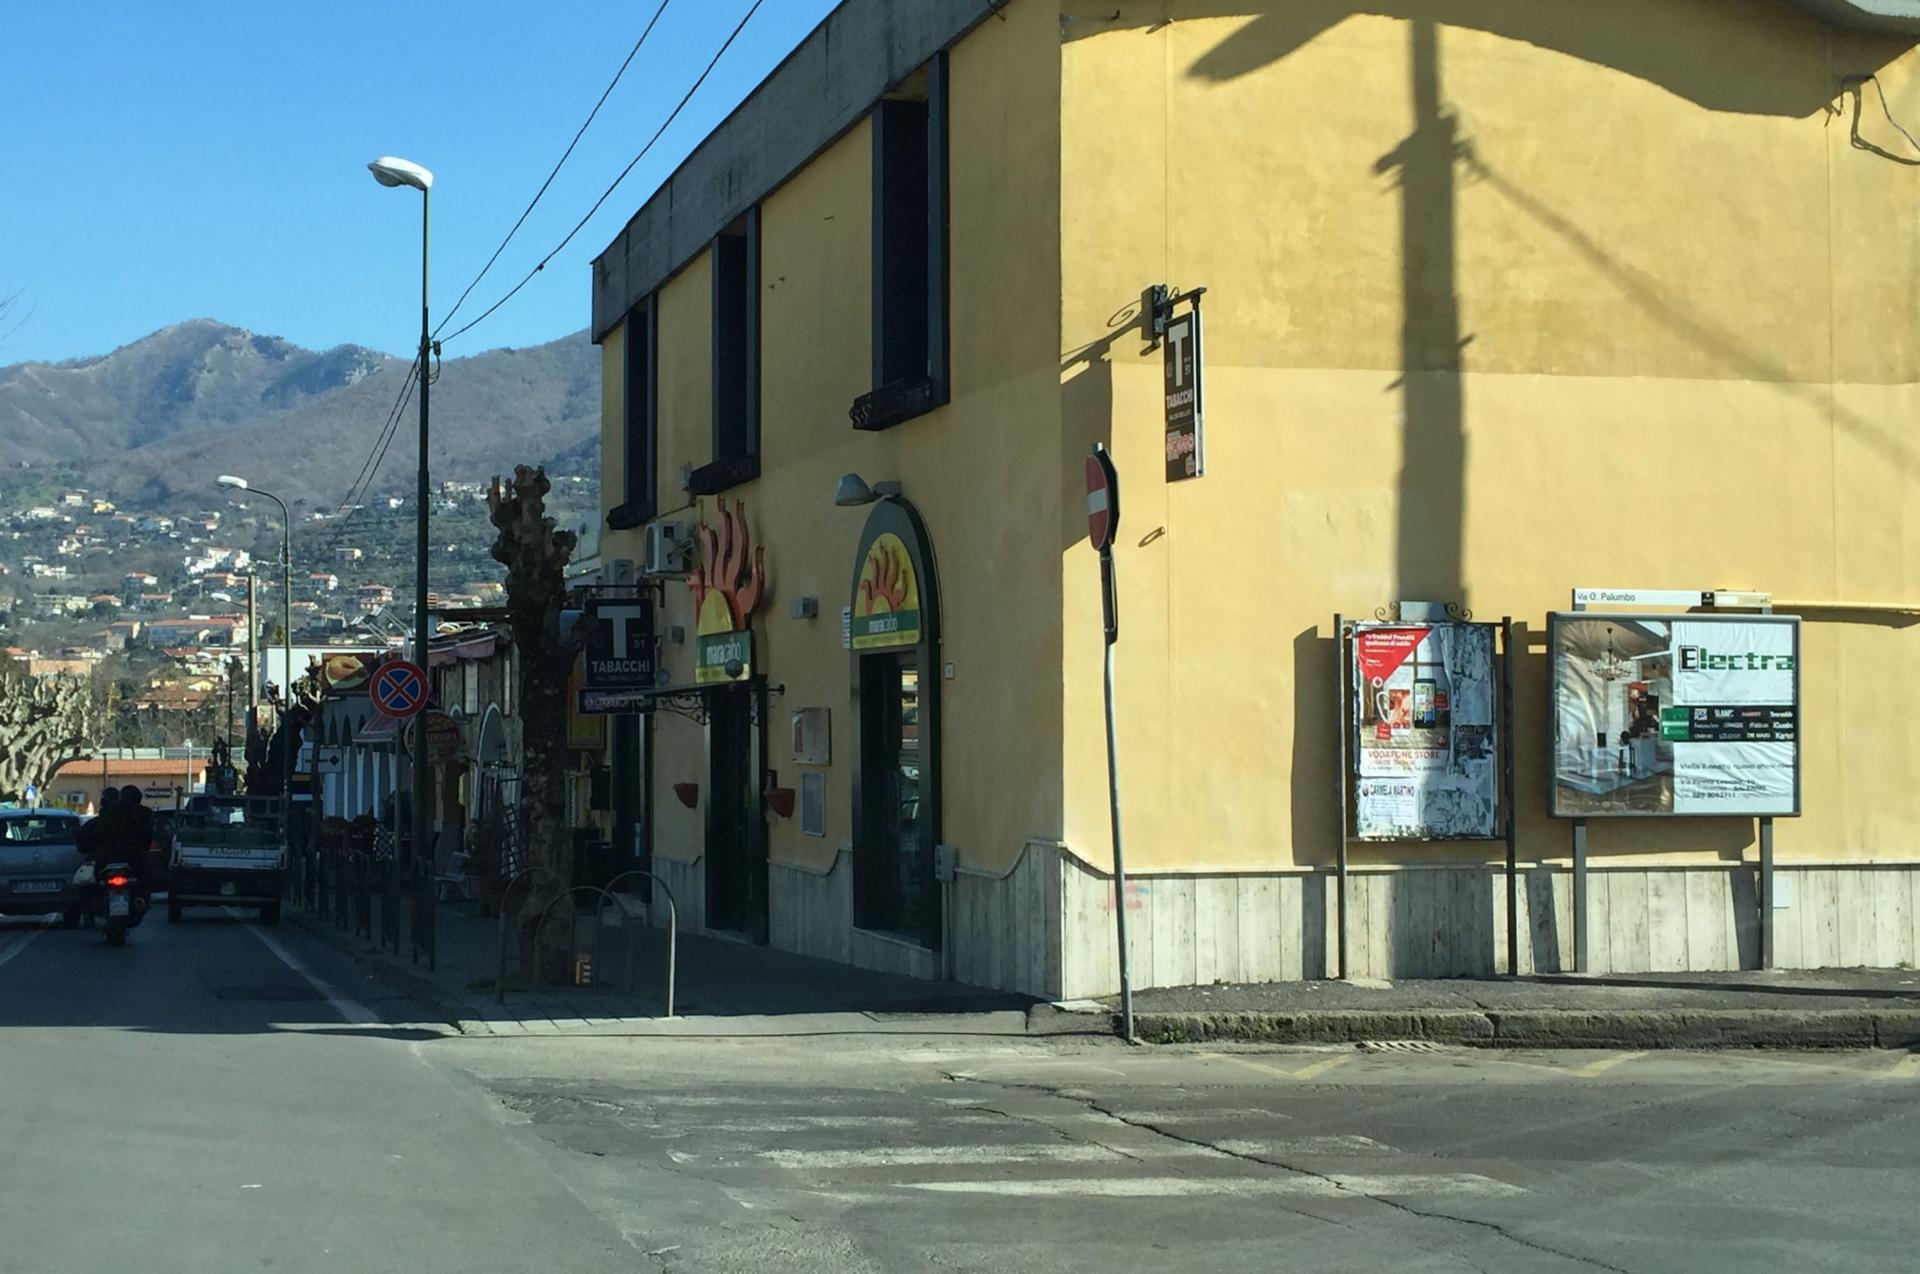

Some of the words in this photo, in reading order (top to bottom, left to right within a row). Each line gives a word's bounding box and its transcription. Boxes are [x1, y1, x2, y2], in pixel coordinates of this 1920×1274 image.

[1168, 320, 1189, 387] T
[1166, 389, 1193, 410] TABACCHI
[1577, 592, 1588, 601] Via
[1600, 592, 1636, 602] Palumbo
[597, 605, 641, 659] T
[633, 639, 646, 649] 51
[1679, 645, 1793, 671] Electra
[591, 660, 651, 673] TABACCHI
[1368, 751, 1414, 760] VODAFONE
[1414, 750, 1440, 760] STORE
[208, 847, 251, 856] PIAGGIO
